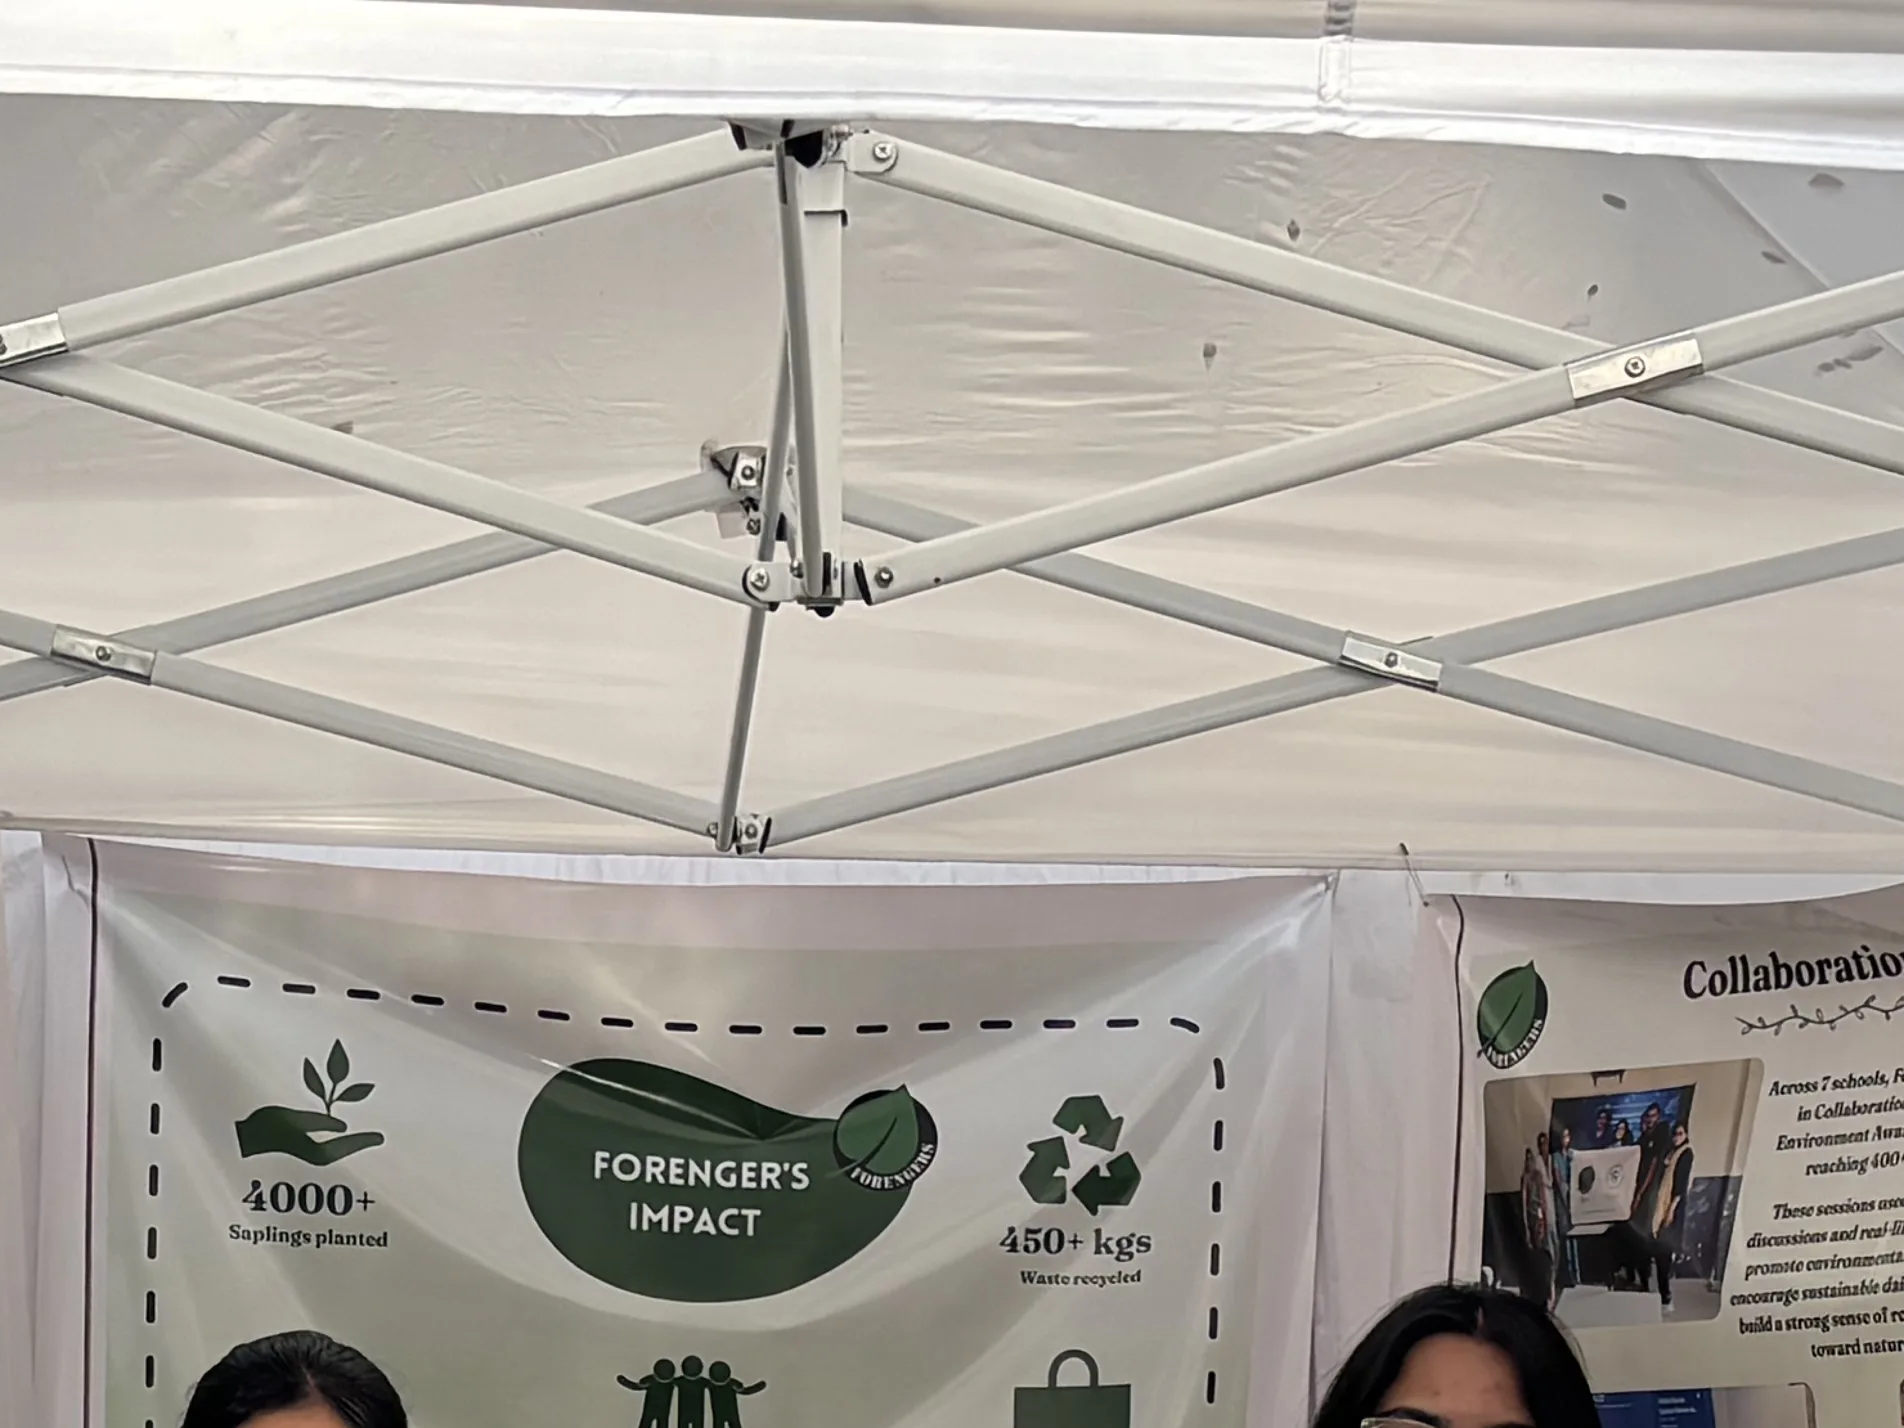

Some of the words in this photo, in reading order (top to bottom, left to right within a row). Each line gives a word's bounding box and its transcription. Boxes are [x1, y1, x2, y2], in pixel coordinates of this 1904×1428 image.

[1769, 1080, 1818, 1097] Across
[1821, 1075, 1831, 1091] 7
[1831, 1070, 1890, 1092] schools,
[1797, 1104, 1812, 1122] in
[1776, 1128, 1871, 1151] Environment
[594, 1150, 810, 1190] FORENGER'S
[851, 1142, 935, 1190] FORENGERS
[241, 1179, 376, 1216] 4000+
[1773, 1203, 1814, 1220] These
[1816, 1199, 1876, 1218] sessions
[629, 1202, 762, 1237] IMPACT
[229, 1224, 311, 1248] Saplings
[316, 1229, 388, 1248] planted
[999, 1226, 1084, 1255] 450+
[1093, 1228, 1152, 1262] kgs
[1747, 1230, 1827, 1249] discussions
[1830, 1223, 1857, 1242] and
[1020, 1270, 1071, 1285] Waste
[1073, 1269, 1142, 1288] recycled
[1873, 1306, 1889, 1324] of
[1811, 1339, 1861, 1358] toward
